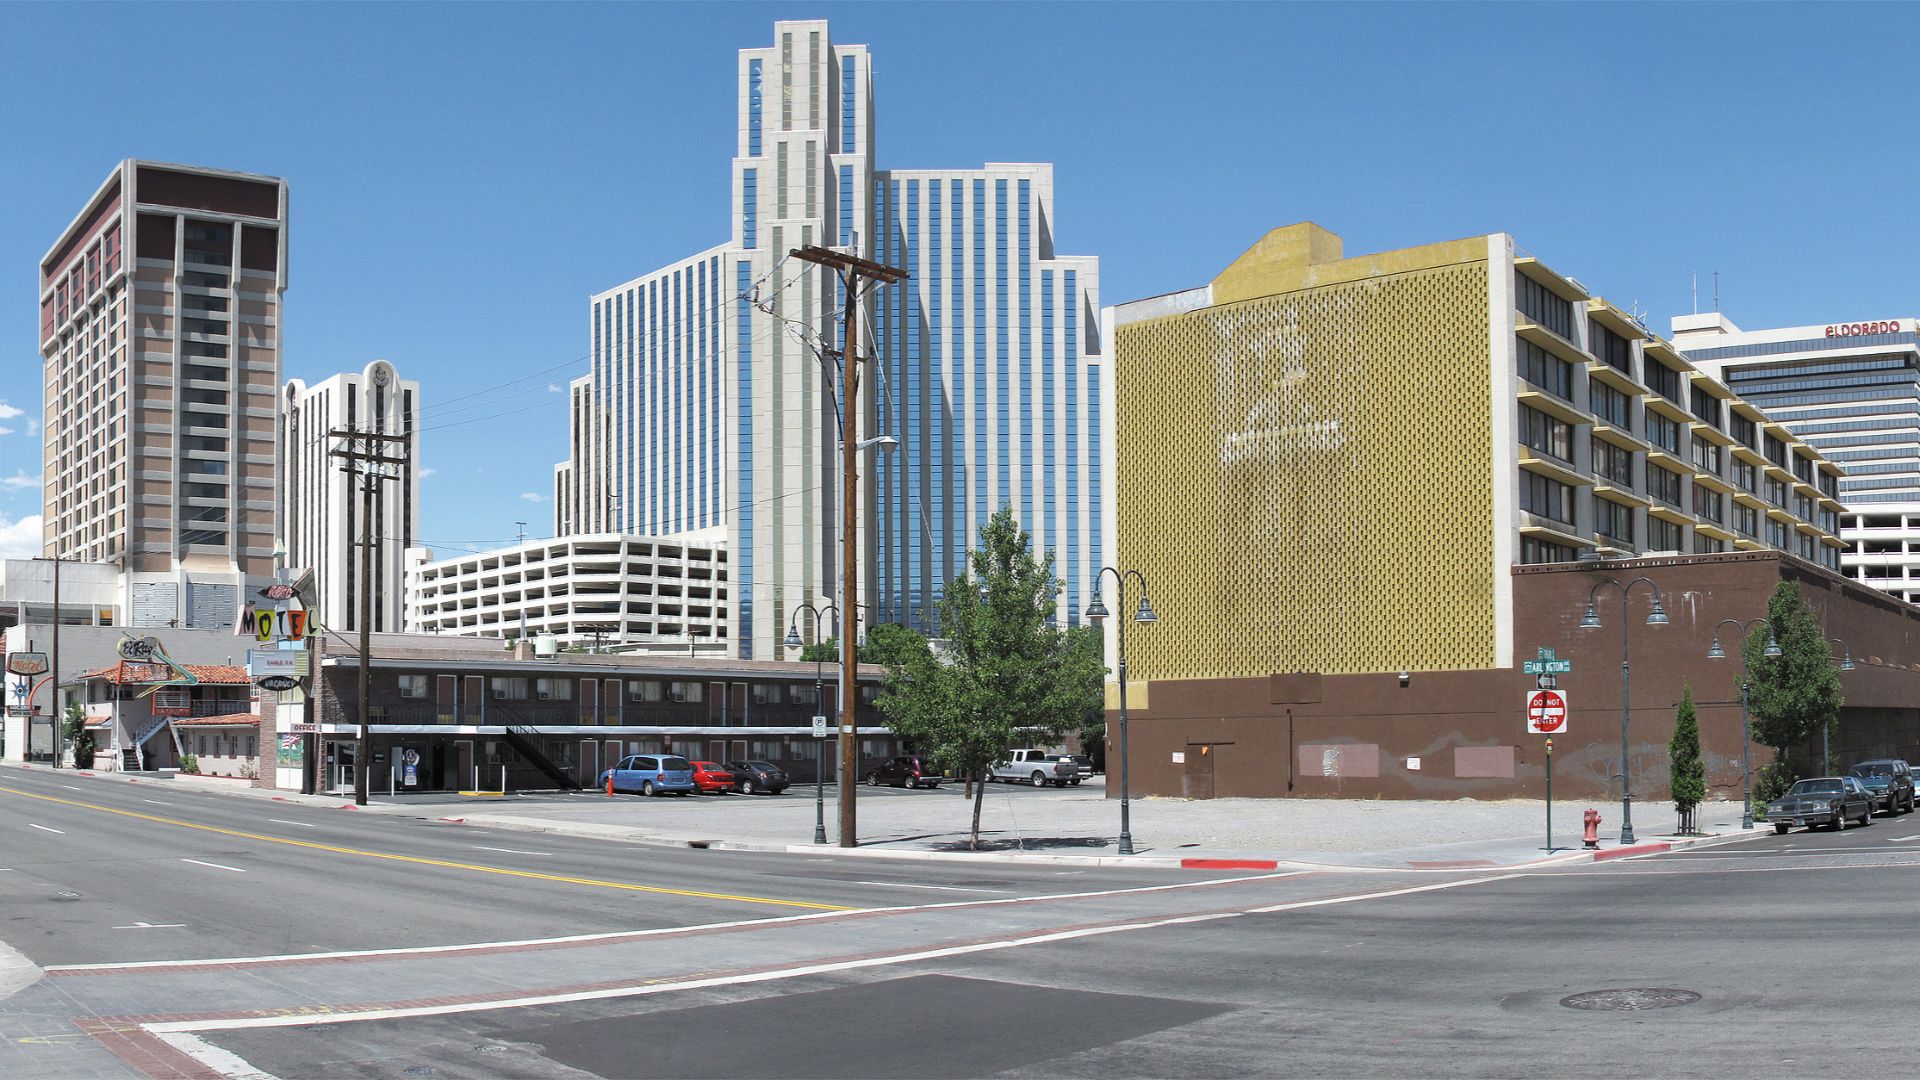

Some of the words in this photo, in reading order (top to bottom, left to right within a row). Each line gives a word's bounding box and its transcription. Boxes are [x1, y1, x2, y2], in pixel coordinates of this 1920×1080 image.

[1826, 321, 1900, 338] ELDORADO
[243, 609, 318, 637] MOTEL
[1532, 661, 1563, 672] ARLNGTON
[265, 678, 296, 688] VACANCY
[1547, 698, 1560, 706] NOT
